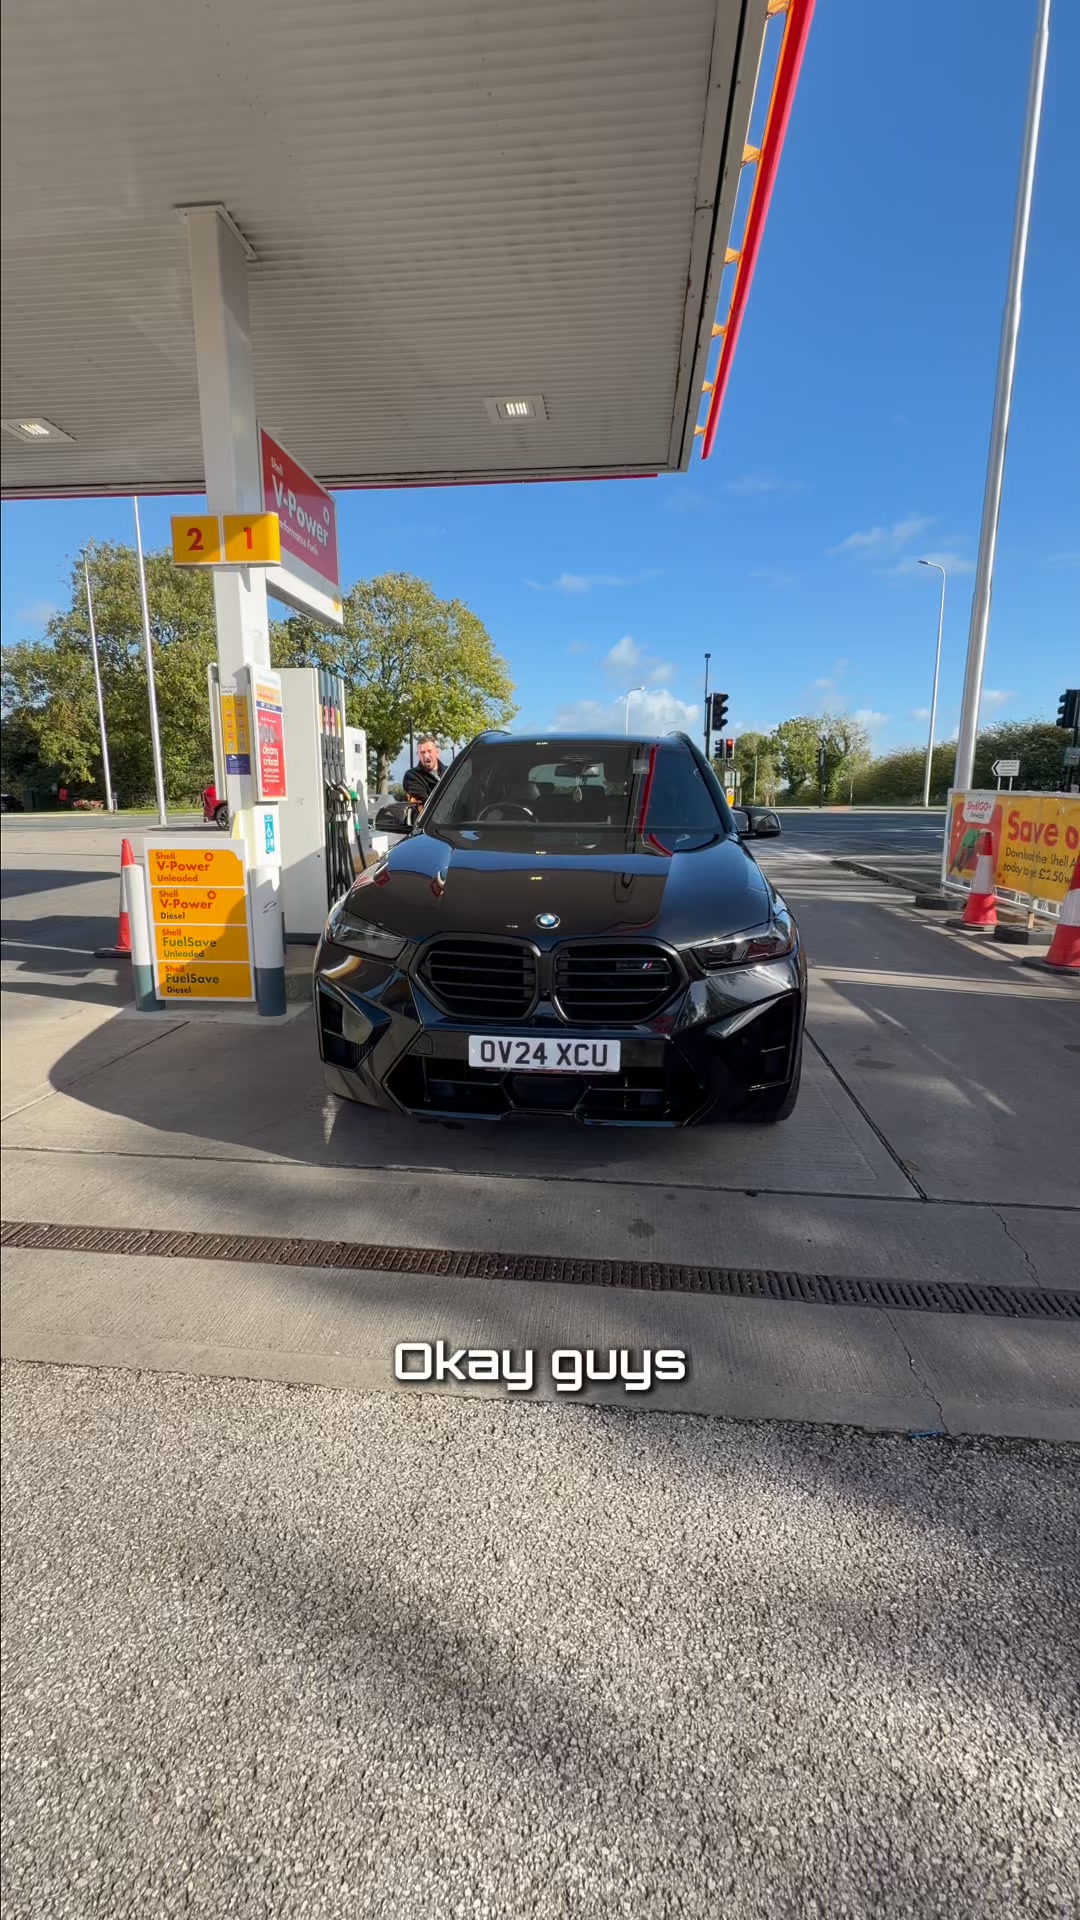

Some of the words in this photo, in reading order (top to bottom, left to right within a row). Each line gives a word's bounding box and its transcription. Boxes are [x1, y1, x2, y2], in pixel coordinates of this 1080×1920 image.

[272, 474, 329, 547] V-Power
[186, 527, 204, 551] 2
[243, 527, 253, 550] 1
[1008, 810, 1059, 847] Save
[1065, 825, 1079, 850] o
[155, 851, 176, 860] Shell
[1005, 846, 1035, 862] Download
[1035, 851, 1048, 864] the
[1050, 853, 1069, 868] Shell
[156, 860, 211, 872] V-Power
[157, 874, 199, 882] Unleaded
[1003, 862, 1023, 876] today
[1038, 868, 1064, 884] £2.50
[159, 890, 179, 898] Shell
[159, 898, 213, 910] V-Power
[160, 912, 186, 920] Diesel
[162, 928, 182, 937] Shell
[163, 936, 217, 948] FuelSave
[163, 950, 205, 958] Unleaded
[165, 965, 185, 973] Shell
[166, 973, 220, 984] FuelSave
[167, 986, 192, 994] Diesel
[480, 1040, 548, 1065] OV24
[556, 1043, 608, 1067] XCU
